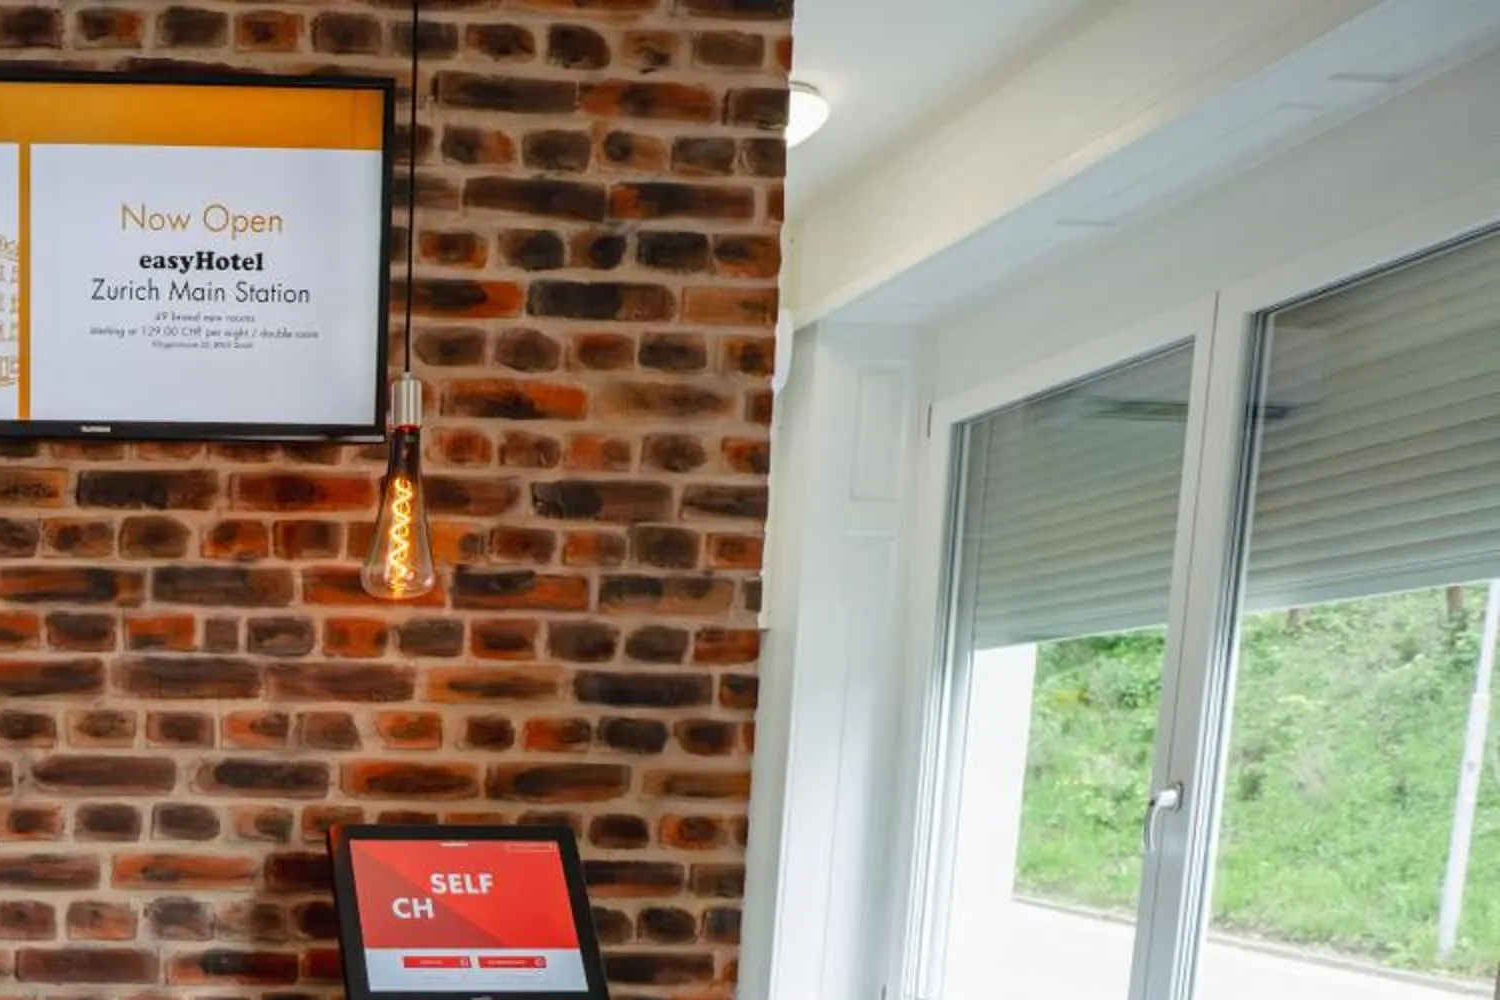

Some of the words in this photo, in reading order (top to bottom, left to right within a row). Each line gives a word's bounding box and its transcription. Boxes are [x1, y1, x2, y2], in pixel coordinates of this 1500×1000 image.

[120, 202, 192, 231] Now
[203, 203, 284, 240] Open
[139, 251, 264, 274] easyHotel
[91, 278, 160, 301] Zurich
[169, 280, 226, 301] Main
[235, 281, 310, 303] Station
[141, 326, 179, 336] 129.00
[430, 872, 494, 894] SELF
[392, 897, 435, 919] CH
